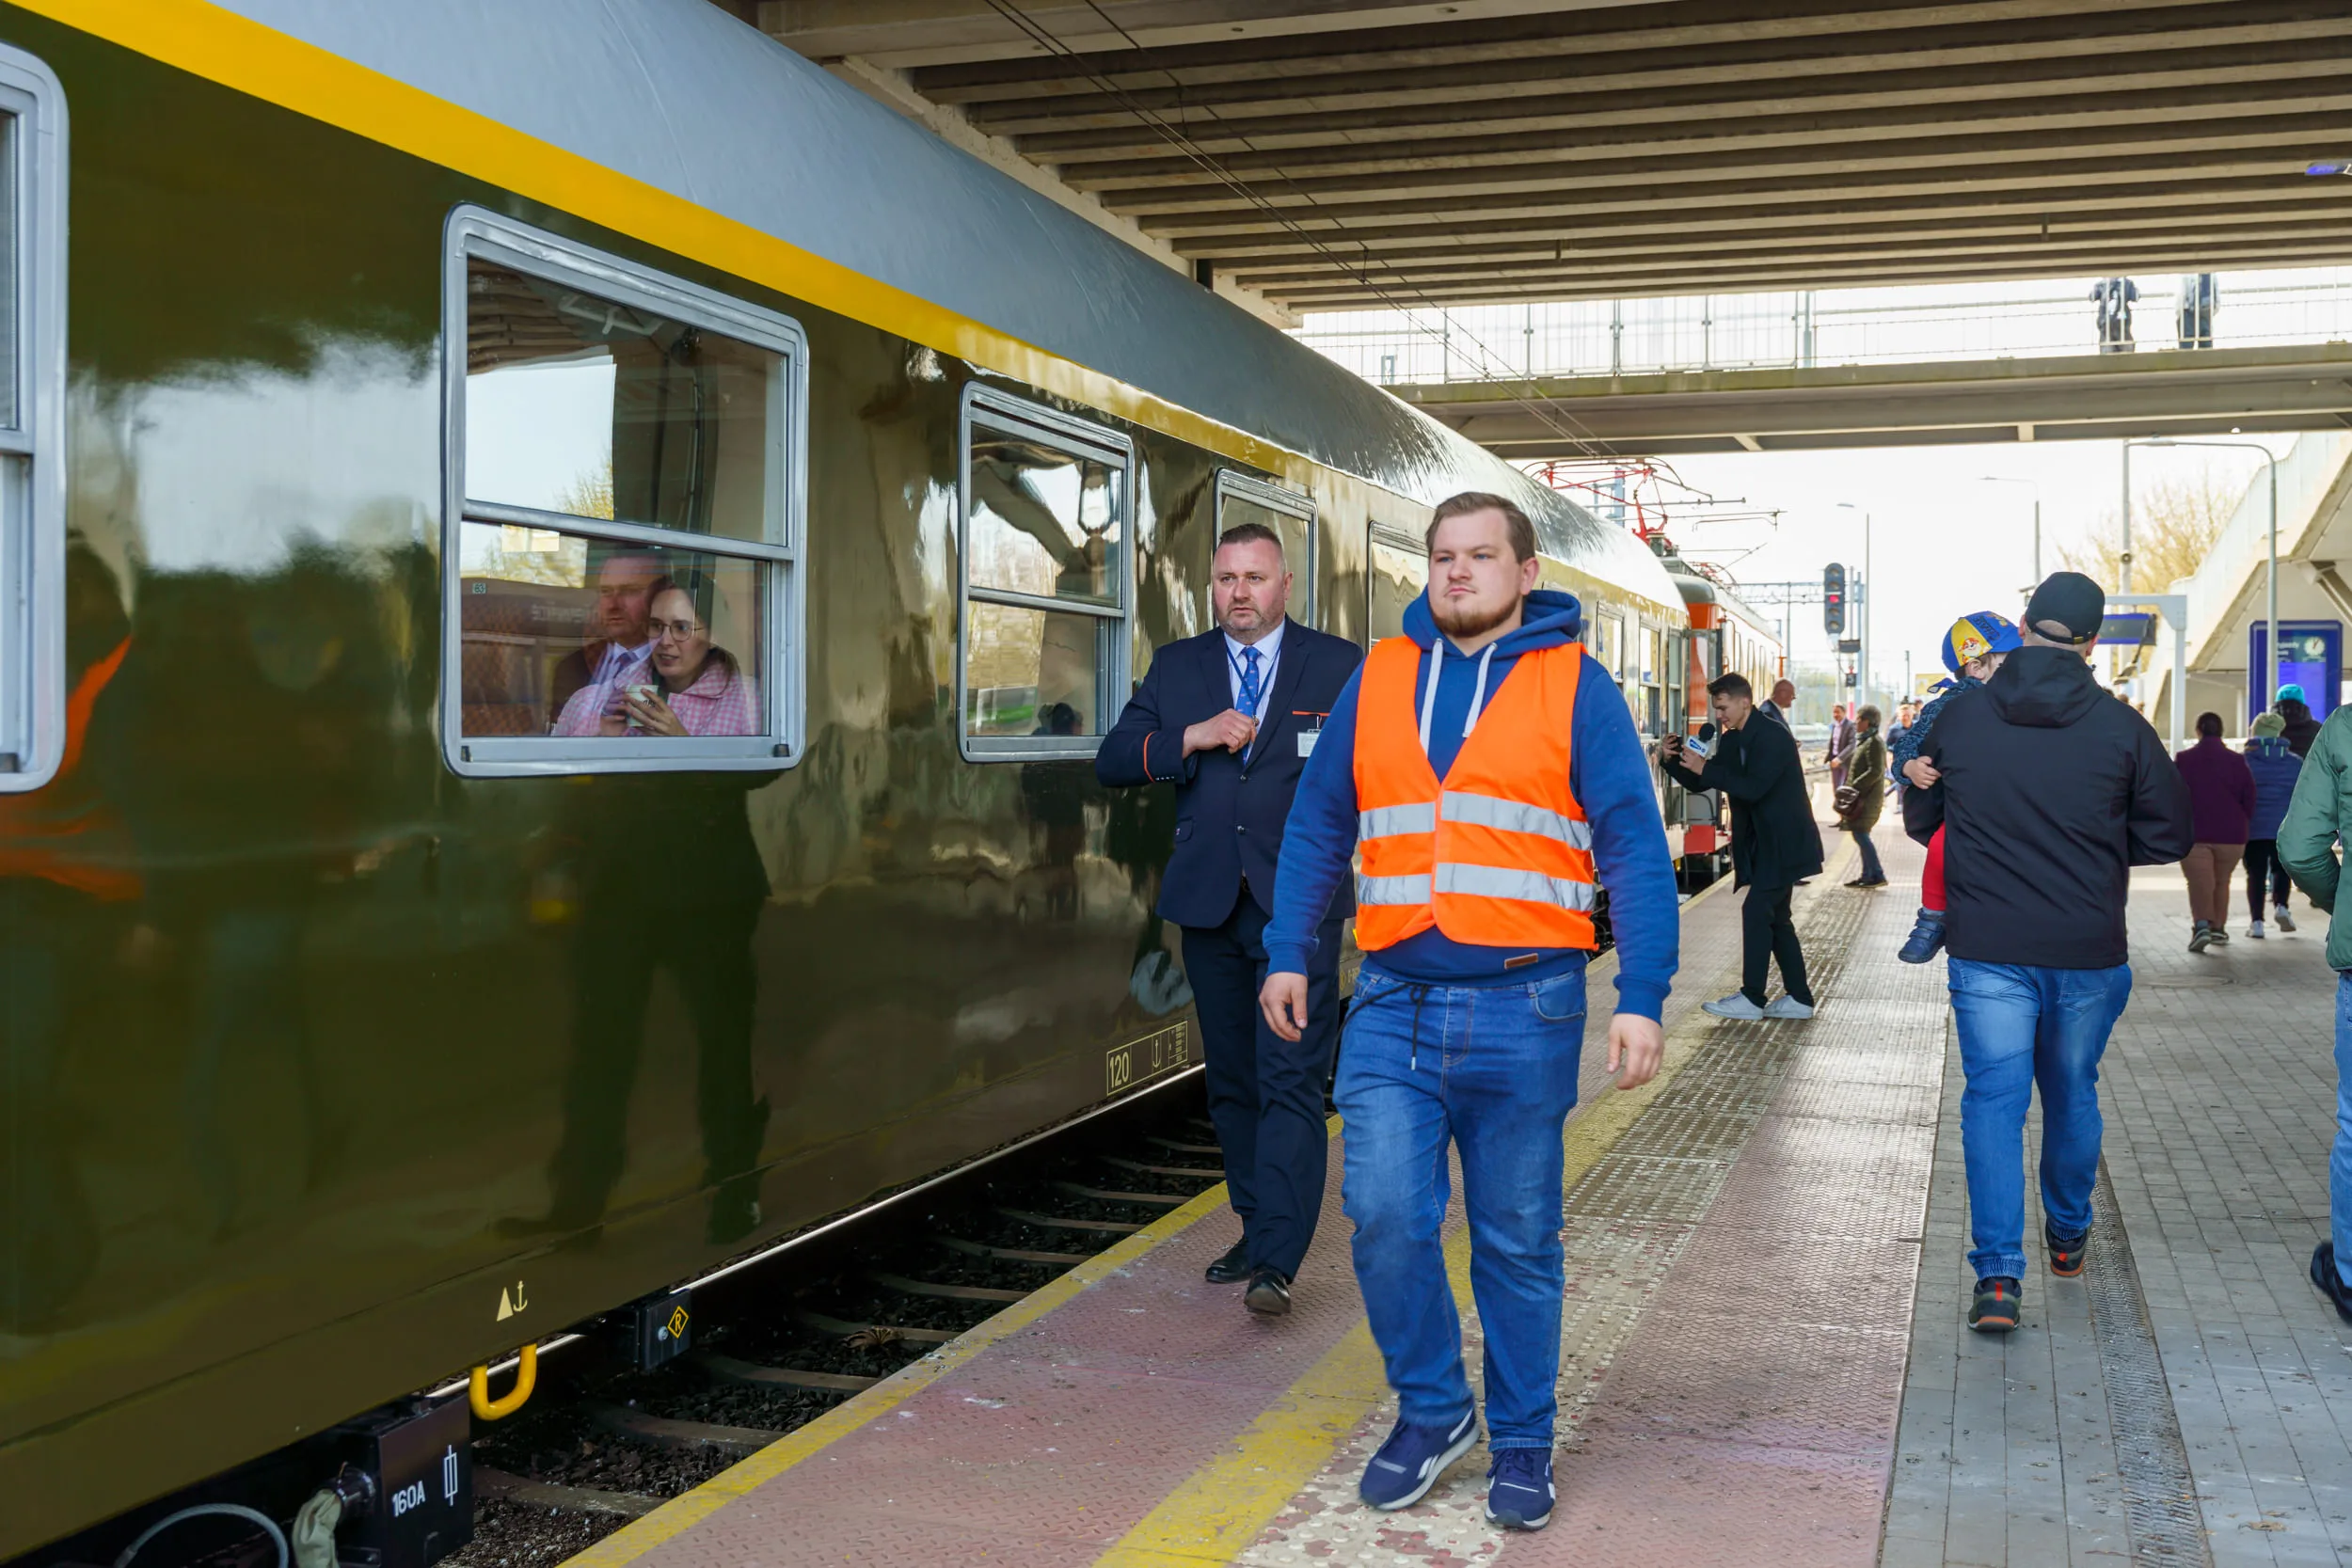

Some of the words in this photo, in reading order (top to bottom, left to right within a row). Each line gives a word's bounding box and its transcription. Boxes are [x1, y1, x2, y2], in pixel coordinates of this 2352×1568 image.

[1109, 1052, 1130, 1088] 120
[675, 1313, 682, 1332] R
[391, 1481, 426, 1517] 160A
